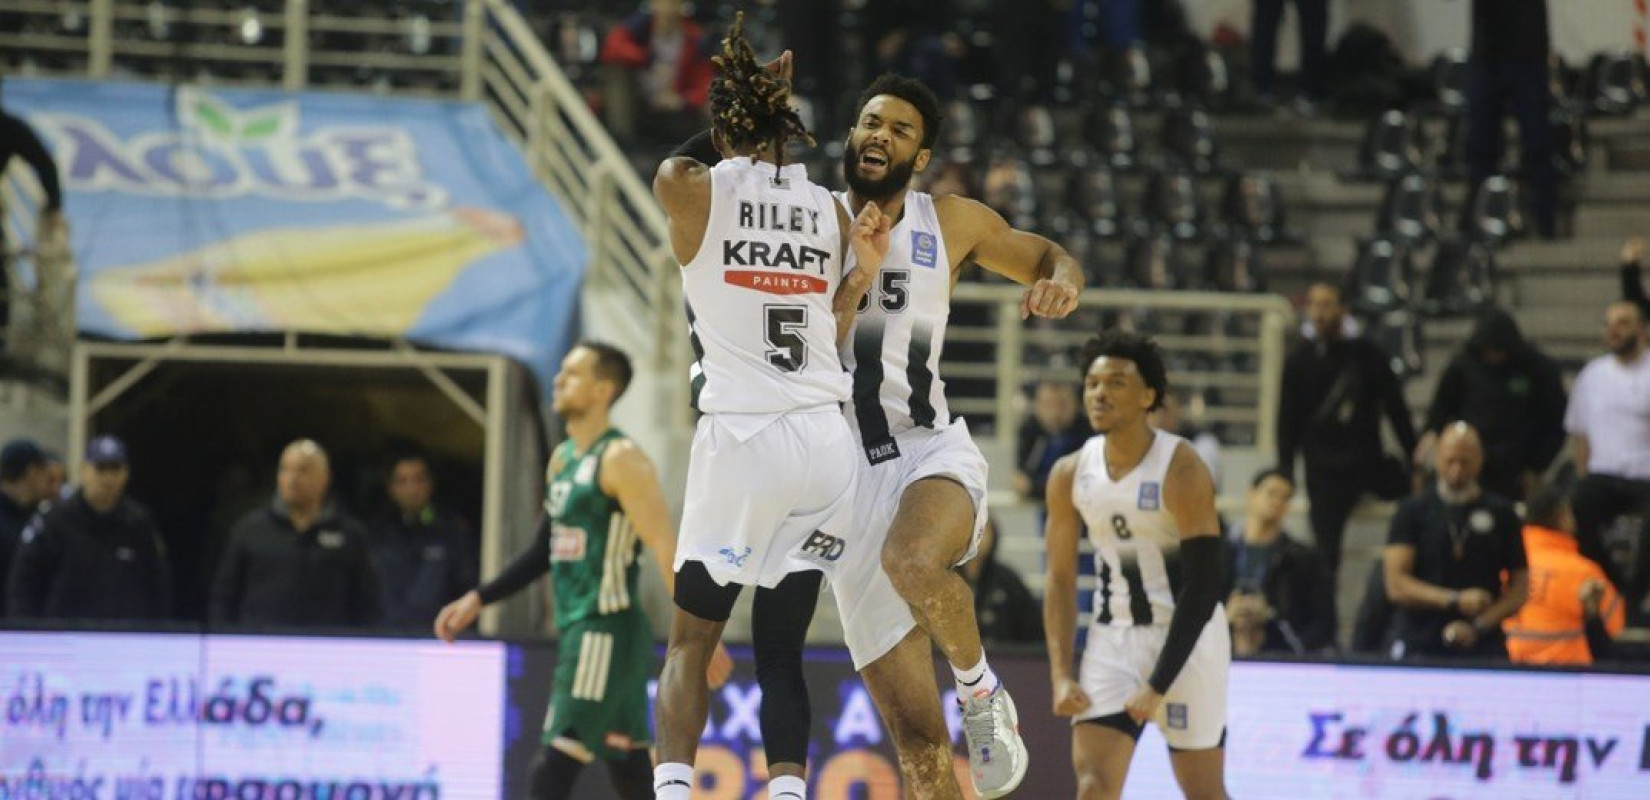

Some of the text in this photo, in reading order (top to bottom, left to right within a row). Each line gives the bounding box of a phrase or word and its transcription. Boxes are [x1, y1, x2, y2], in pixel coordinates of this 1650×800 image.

[739, 202, 820, 235] RILEY
[723, 239, 831, 274] KRAFT
[753, 275, 810, 289] PAINTS
[763, 303, 808, 373] 5
[1110, 513, 1133, 540] 8
[1384, 711, 1495, 781] όλη
[1512, 735, 1618, 784] την
